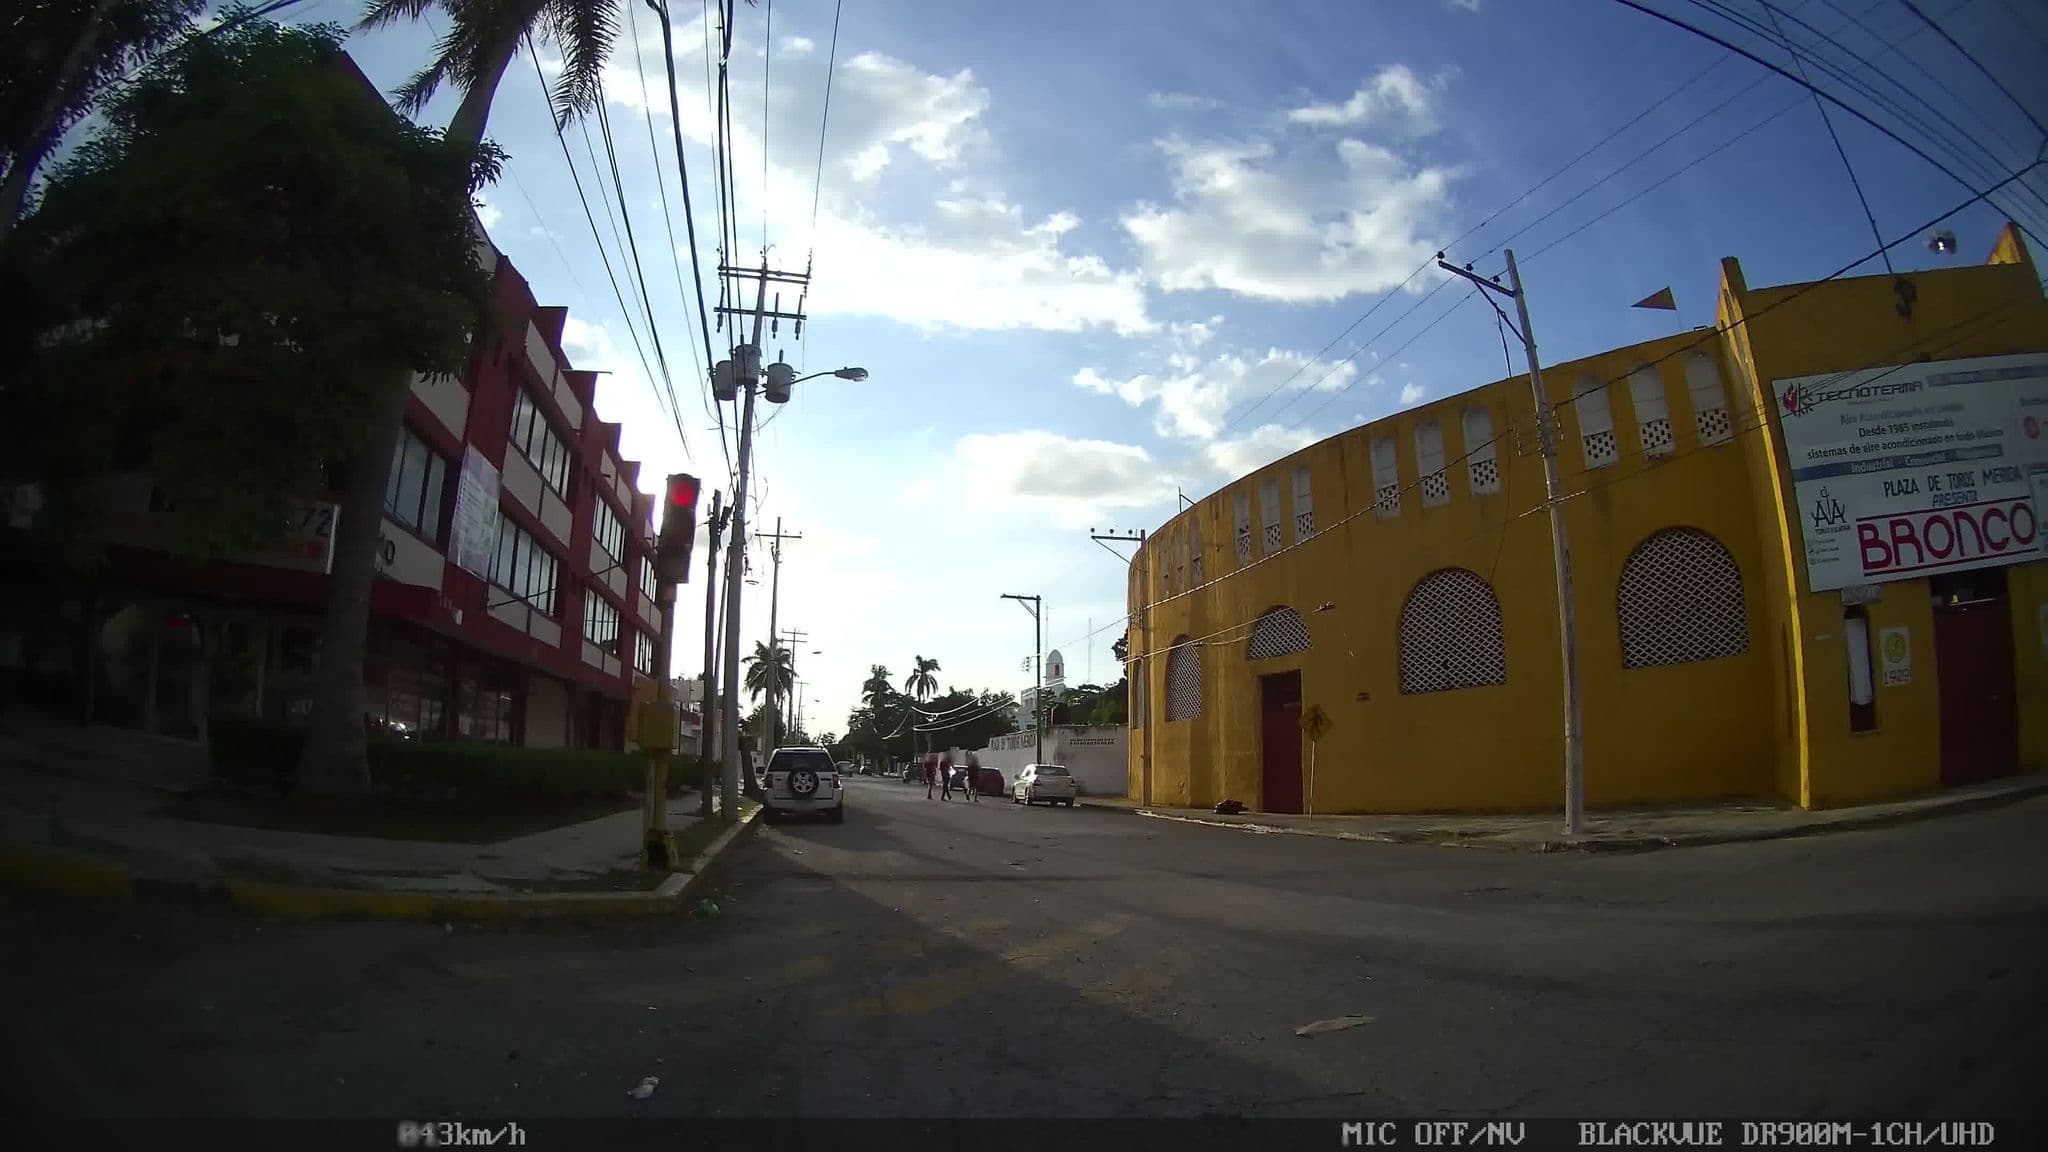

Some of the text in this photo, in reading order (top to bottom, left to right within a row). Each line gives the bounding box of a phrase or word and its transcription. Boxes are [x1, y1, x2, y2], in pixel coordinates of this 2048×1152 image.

[1815, 382, 1922, 402] TECNOTERMA
[1858, 426, 1887, 438] Desde
[1807, 448, 1848, 460] sistemas
[1849, 443, 1862, 454] de
[1863, 441, 1880, 453] aire
[1851, 458, 1893, 473] Industrial
[1883, 478, 1920, 498] PLAZA
[1927, 474, 1942, 491] DE
[1946, 471, 1976, 490] TOROS
[1932, 489, 1978, 507] PRESENTA
[1857, 502, 2036, 570] BRONCO
